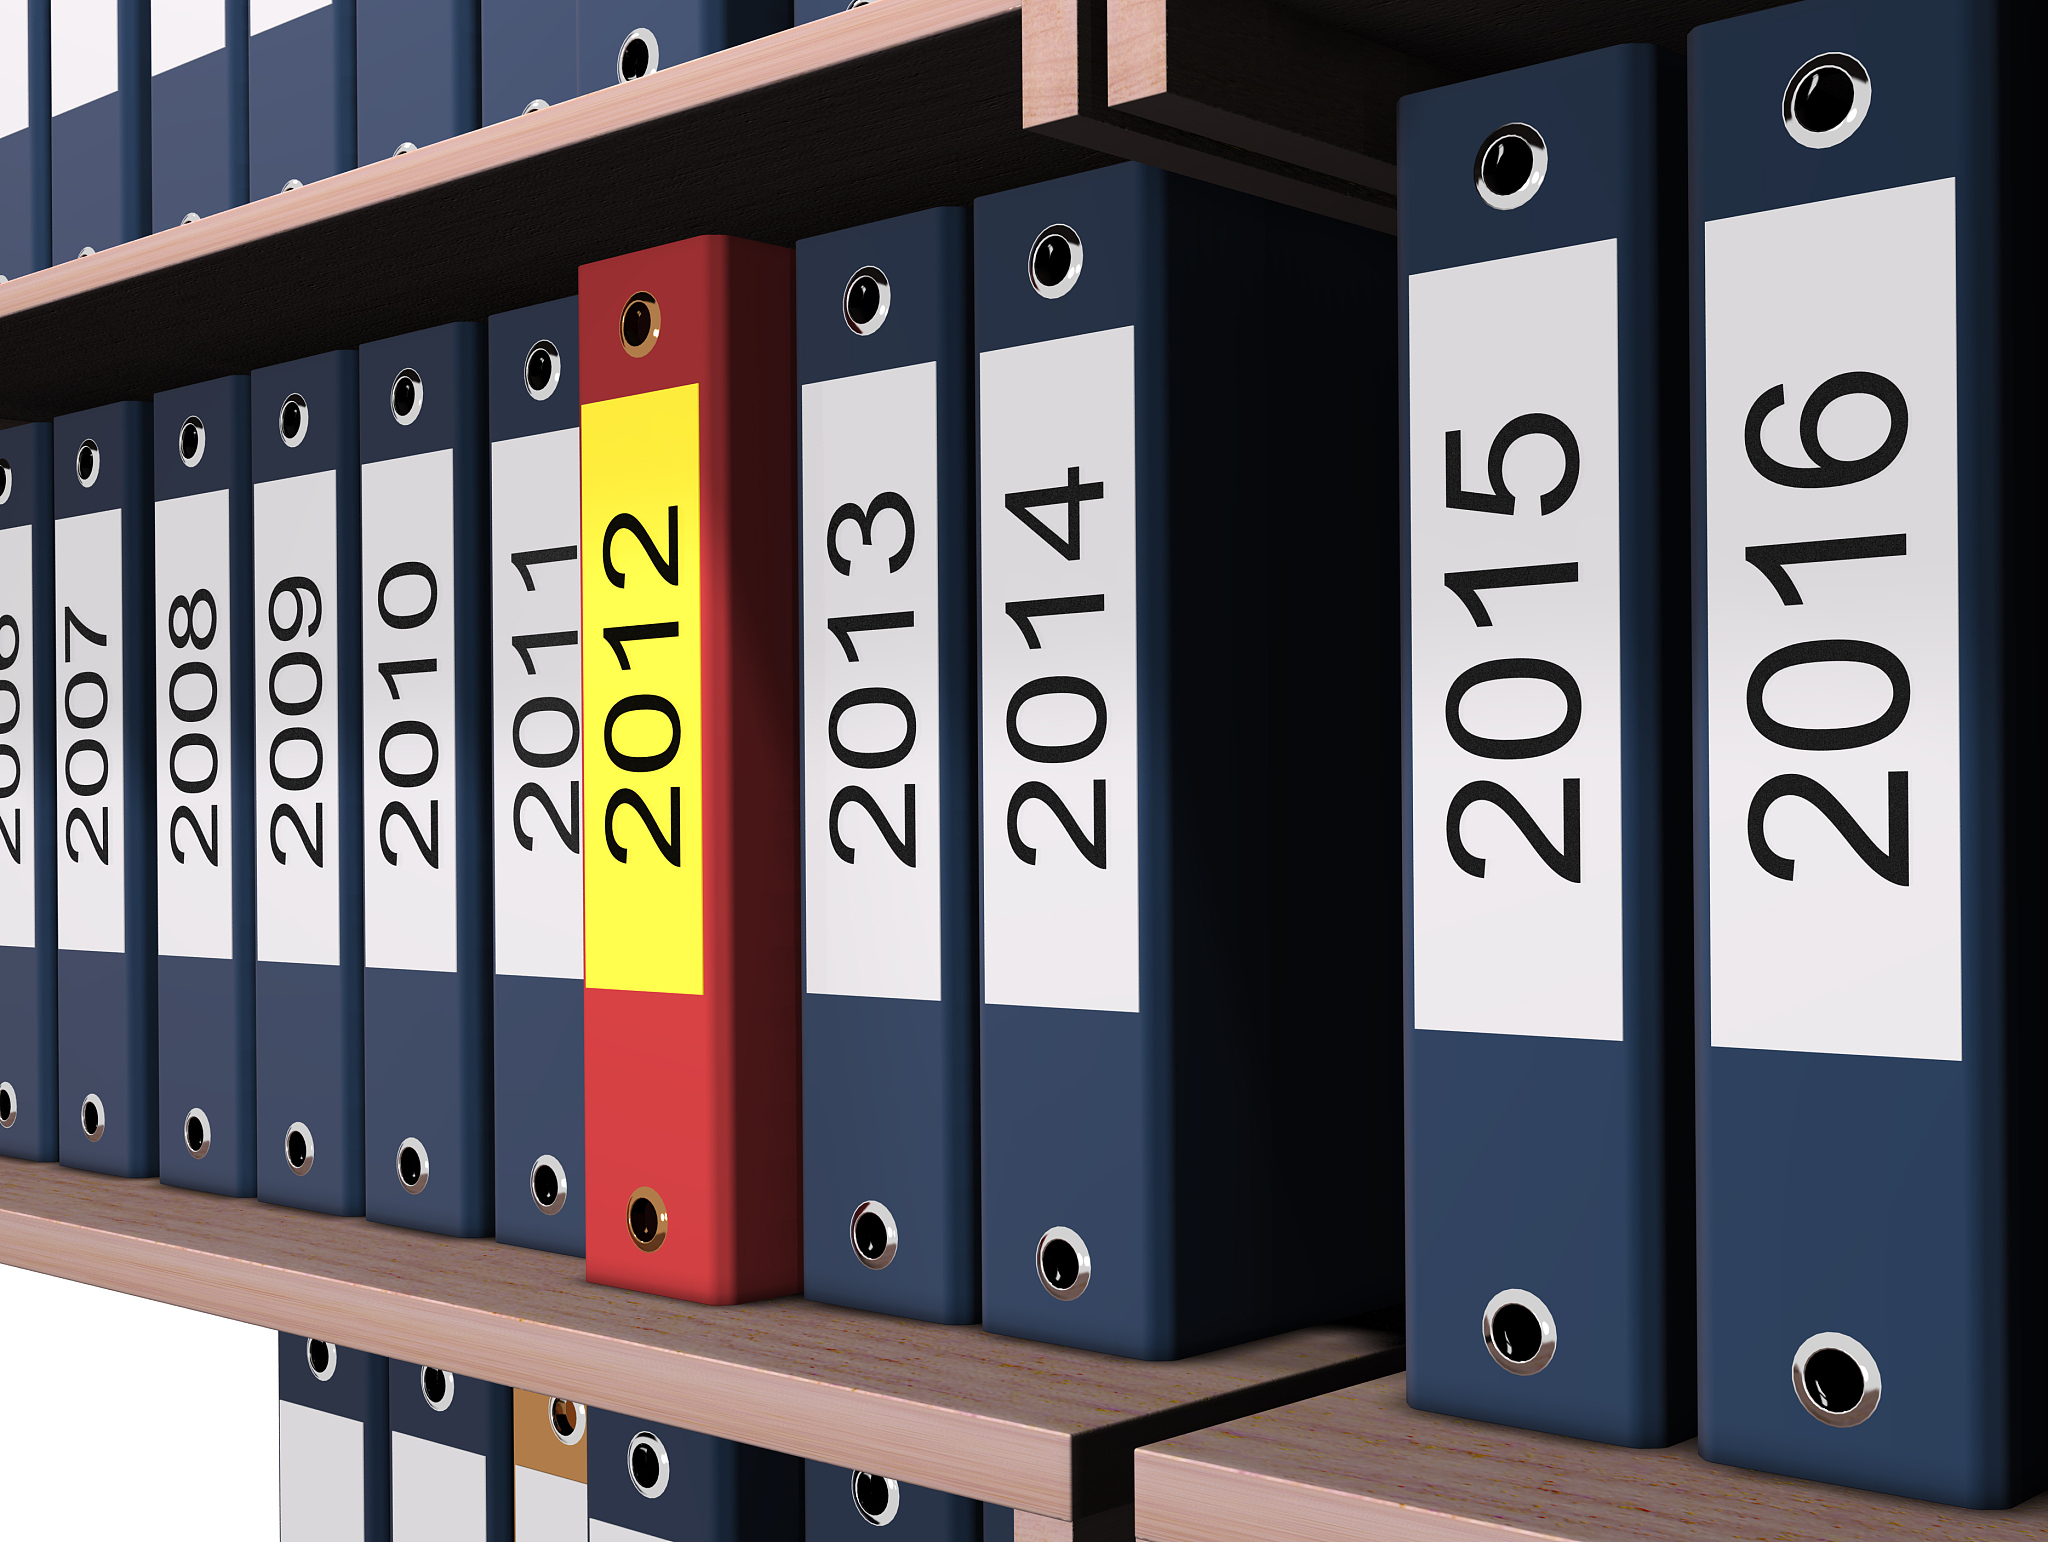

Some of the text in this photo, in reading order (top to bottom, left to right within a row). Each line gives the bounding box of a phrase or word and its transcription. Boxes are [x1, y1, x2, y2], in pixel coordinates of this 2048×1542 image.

[65, 607, 108, 865] 2007
[169, 589, 218, 866] 2008
[269, 577, 323, 868] 2009
[378, 562, 438, 869] 2010
[511, 545, 579, 854] 2011
[603, 506, 681, 867] 2012
[827, 492, 916, 868] 2013
[1005, 466, 1107, 869] 2014
[1446, 413, 1581, 883] 2015
[1745, 372, 1910, 886] 2016
